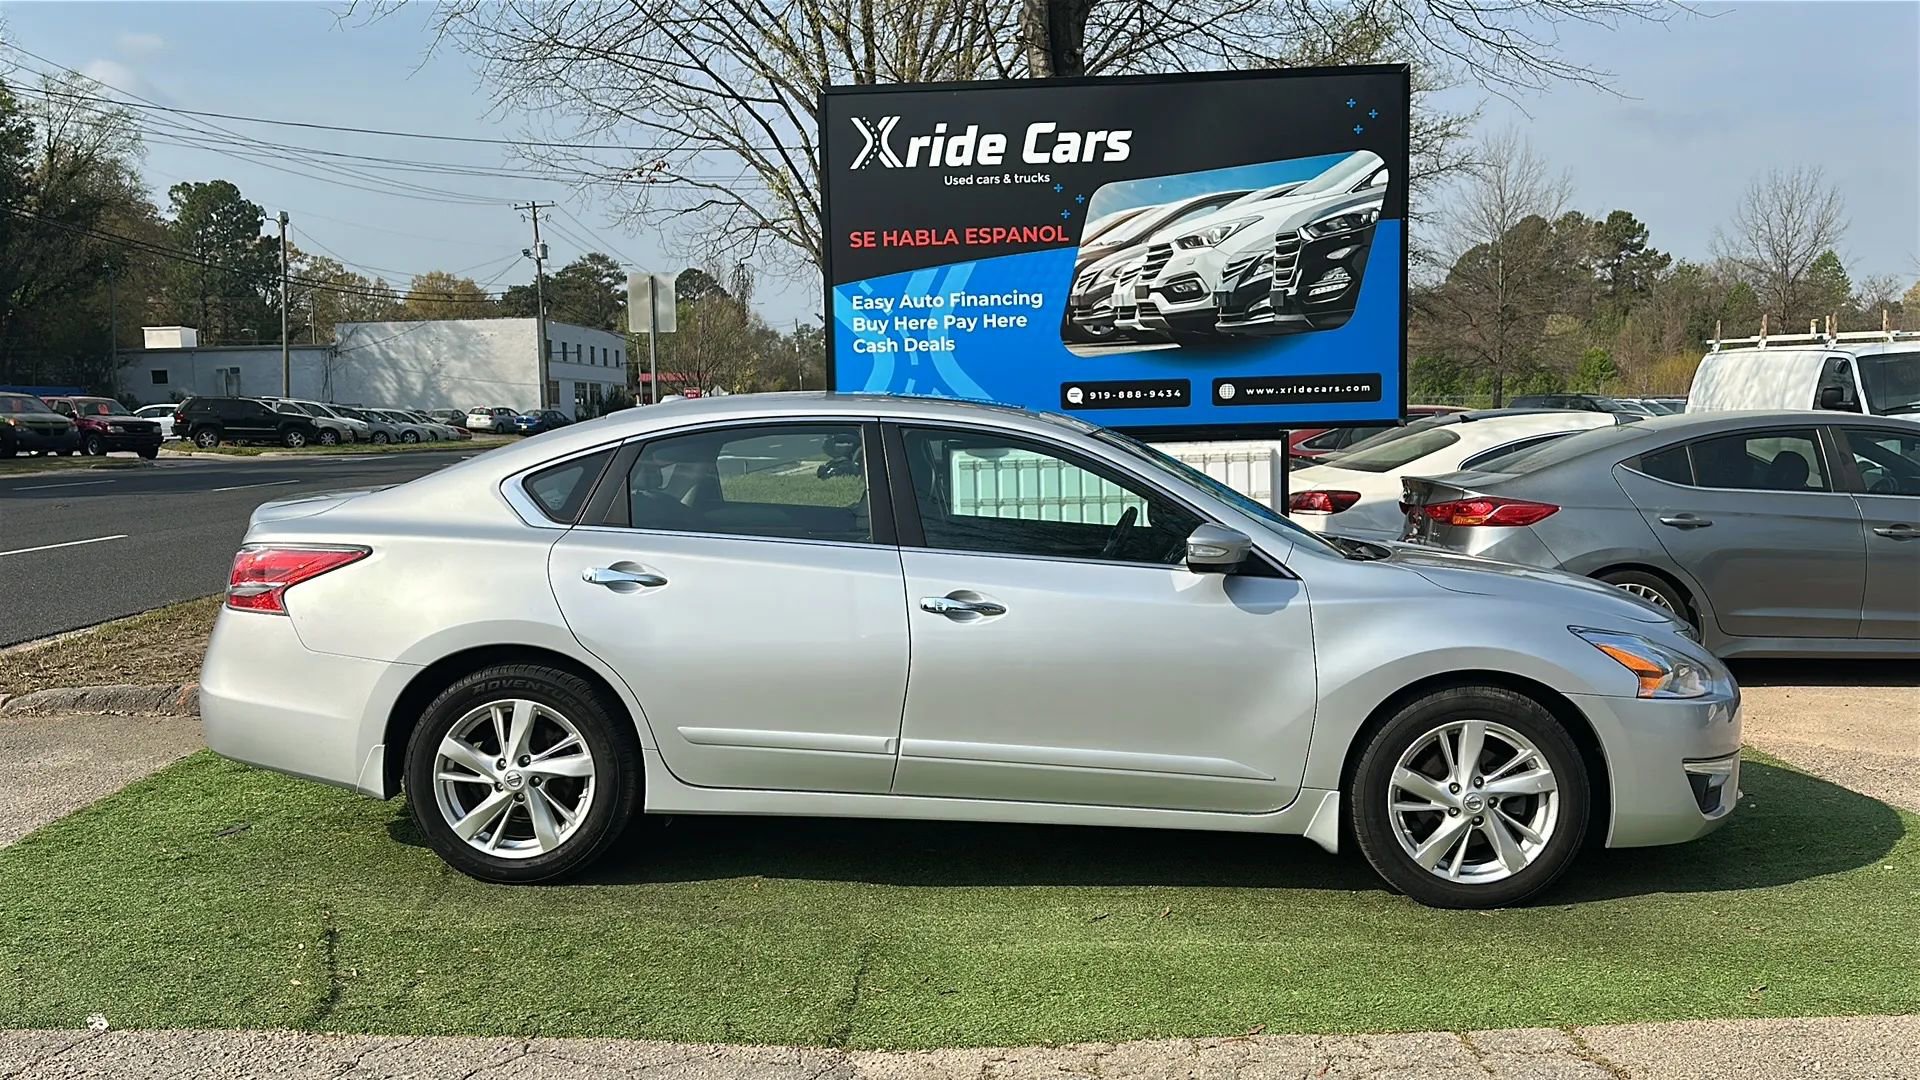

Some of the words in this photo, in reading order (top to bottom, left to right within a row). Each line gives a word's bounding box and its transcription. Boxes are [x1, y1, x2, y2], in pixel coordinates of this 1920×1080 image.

[850, 116, 1006, 169] Xride
[1023, 122, 1132, 163] Cars
[945, 175, 973, 185] Used
[976, 176, 1000, 184] cars
[1003, 174, 1011, 183] &
[1014, 173, 1050, 183] trucks
[850, 231, 876, 248] SE
[884, 229, 959, 246] HABLA
[966, 226, 1069, 244] ESPANOL
[853, 296, 894, 312] Easy
[900, 295, 944, 308] Auto
[951, 290, 1042, 308] Financing
[854, 318, 888, 334] Buy
[895, 317, 937, 330] Here
[944, 315, 977, 331] Pay
[984, 314, 1027, 327] Here
[854, 338, 897, 353] Cash
[905, 337, 954, 351] Deals
[1089, 389, 1181, 400] 919-888-9434
[1246, 383, 1371, 396] www.xridecars.com
